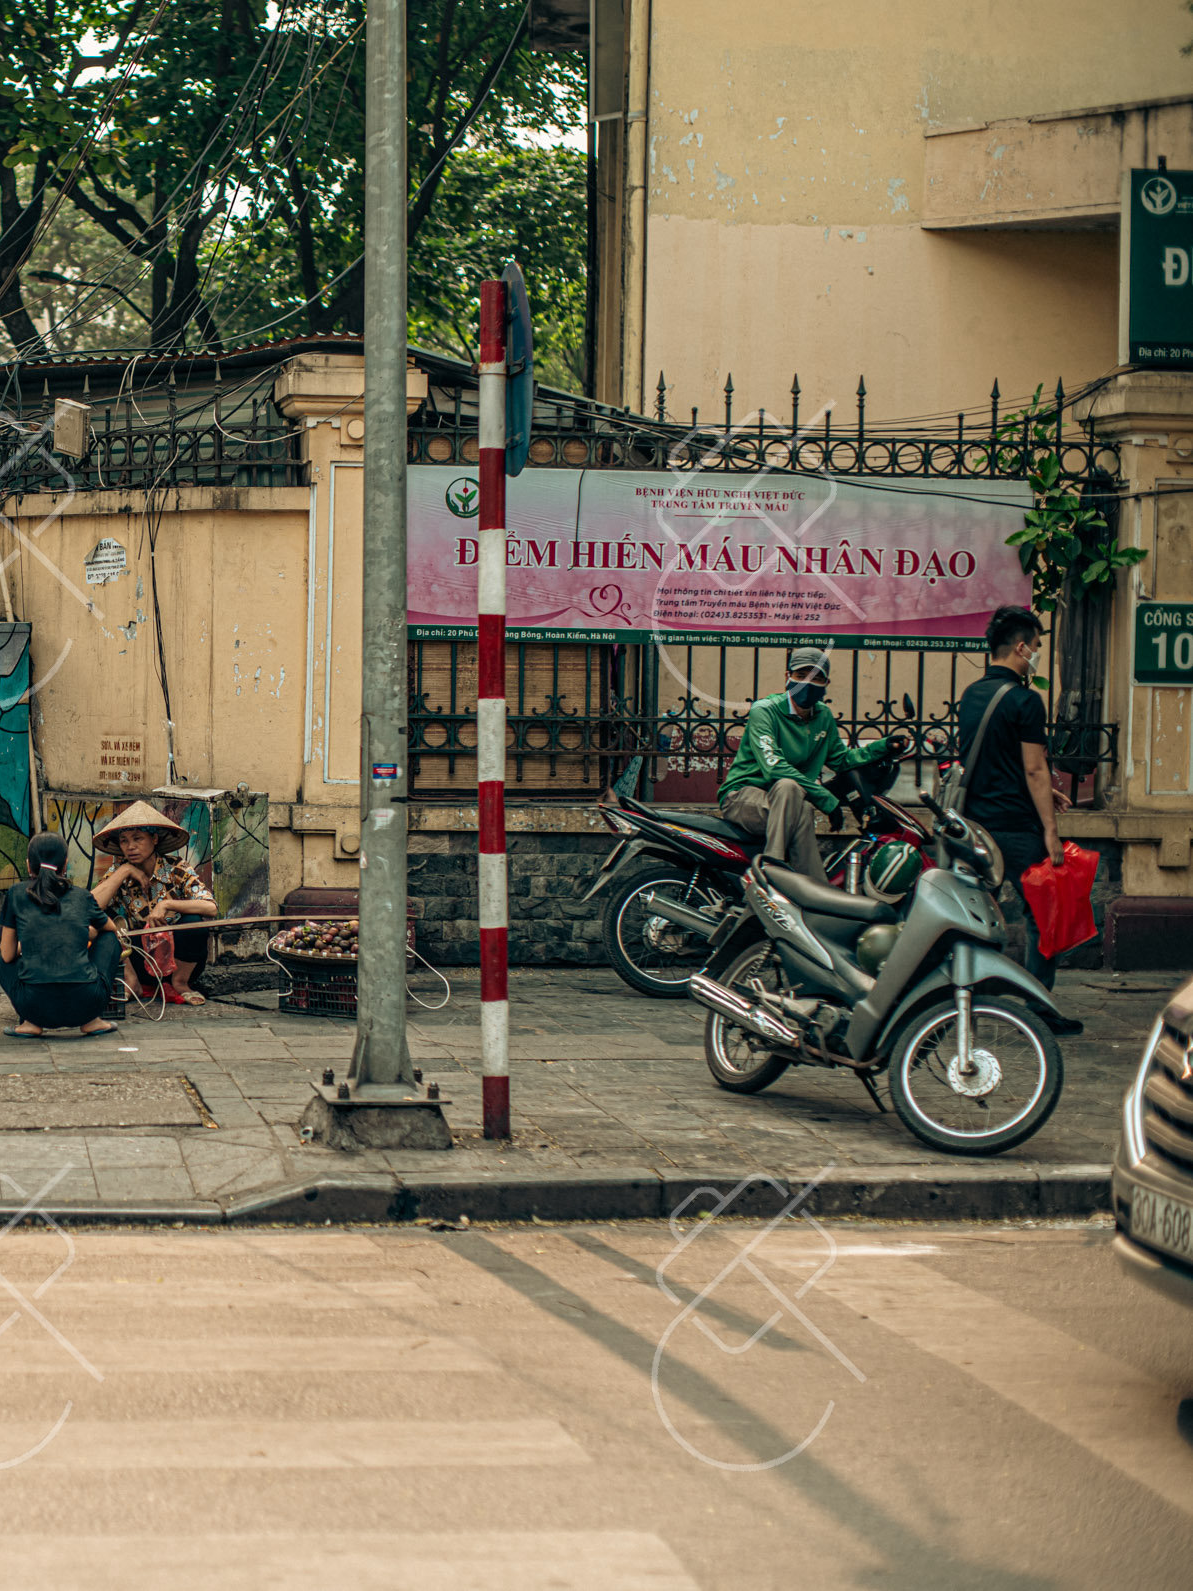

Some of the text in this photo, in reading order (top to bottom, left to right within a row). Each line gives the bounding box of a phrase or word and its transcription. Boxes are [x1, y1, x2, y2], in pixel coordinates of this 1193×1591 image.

[1162, 247, 1193, 286] Đ
[1170, 348, 1181, 358] 20
[635, 487, 806, 501] BỆNH VIỆN HỮU NGHỊ VIỆT ĐỨC
[651, 500, 688, 509] TRUNG
[692, 500, 715, 509] TÂM
[765, 501, 789, 511] MÁU
[455, 530, 976, 585] ĐỂM HIẾN MÁU NHÂN ĐẠO
[657, 588, 672, 596] Mọi
[674, 588, 699, 596] thông
[701, 588, 712, 596] tin
[728, 588, 743, 596] tiết
[776, 590, 786, 598] hệ
[788, 591, 805, 599] trực
[656, 599, 679, 607] Trung
[681, 599, 697, 607] tâm
[699, 599, 727, 608] Truyền
[729, 600, 747, 608] máu
[749, 601, 769, 609] Bệnh
[772, 601, 789, 610] viện
[806, 602, 822, 610] Việt
[654, 610, 672, 618] Điện
[774, 613, 790, 621] Máy
[804, 613, 820, 621] 252
[1144, 607, 1182, 627] CỔNG
[416, 628, 429, 637] Địa
[447, 629, 457, 637] 20
[458, 628, 474, 637] Phủ
[504, 630, 616, 640] àng Bông, Hoàn Kiếm, Hà Nội
[668, 634, 685, 643] gian
[687, 634, 700, 642] làm
[721, 635, 741, 643] 7h30
[793, 637, 798, 645] 2
[863, 638, 882, 646] Điện
